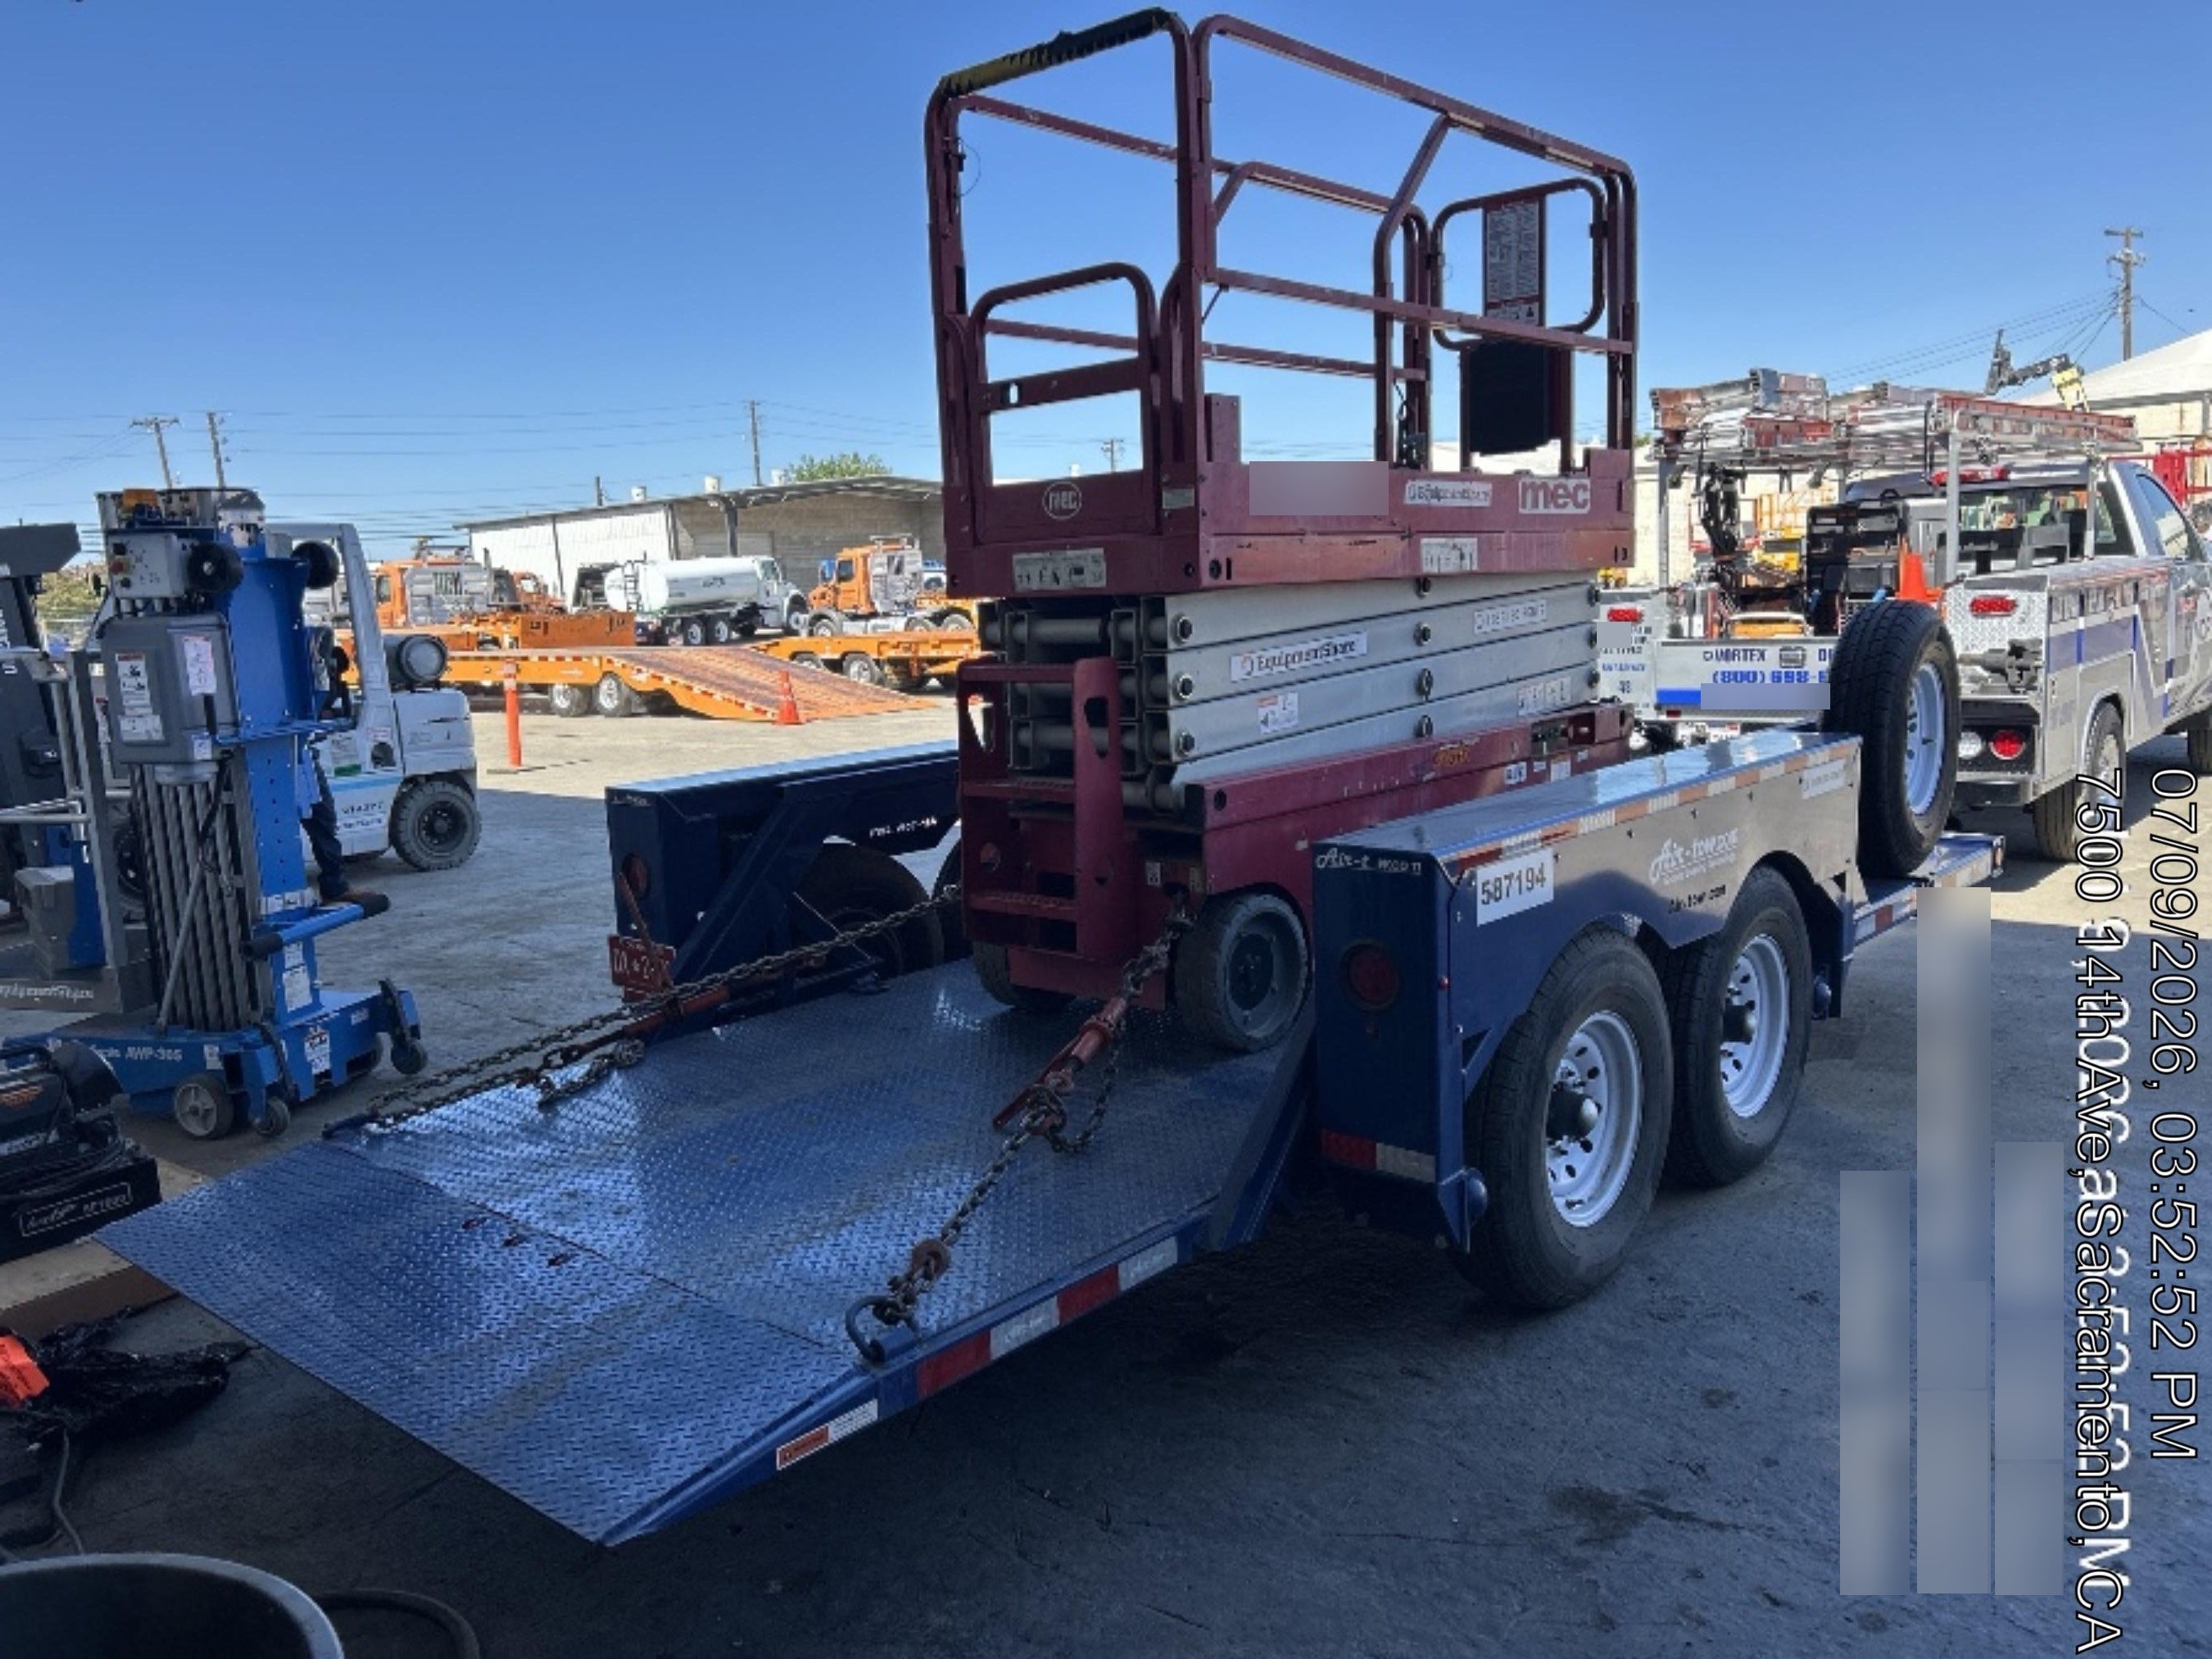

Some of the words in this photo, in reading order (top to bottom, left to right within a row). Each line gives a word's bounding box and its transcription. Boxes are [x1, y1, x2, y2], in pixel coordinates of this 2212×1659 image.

[1521, 480, 1589, 510] mec
[1713, 670, 1766, 683] (800)
[1481, 862, 1547, 905] 587194
